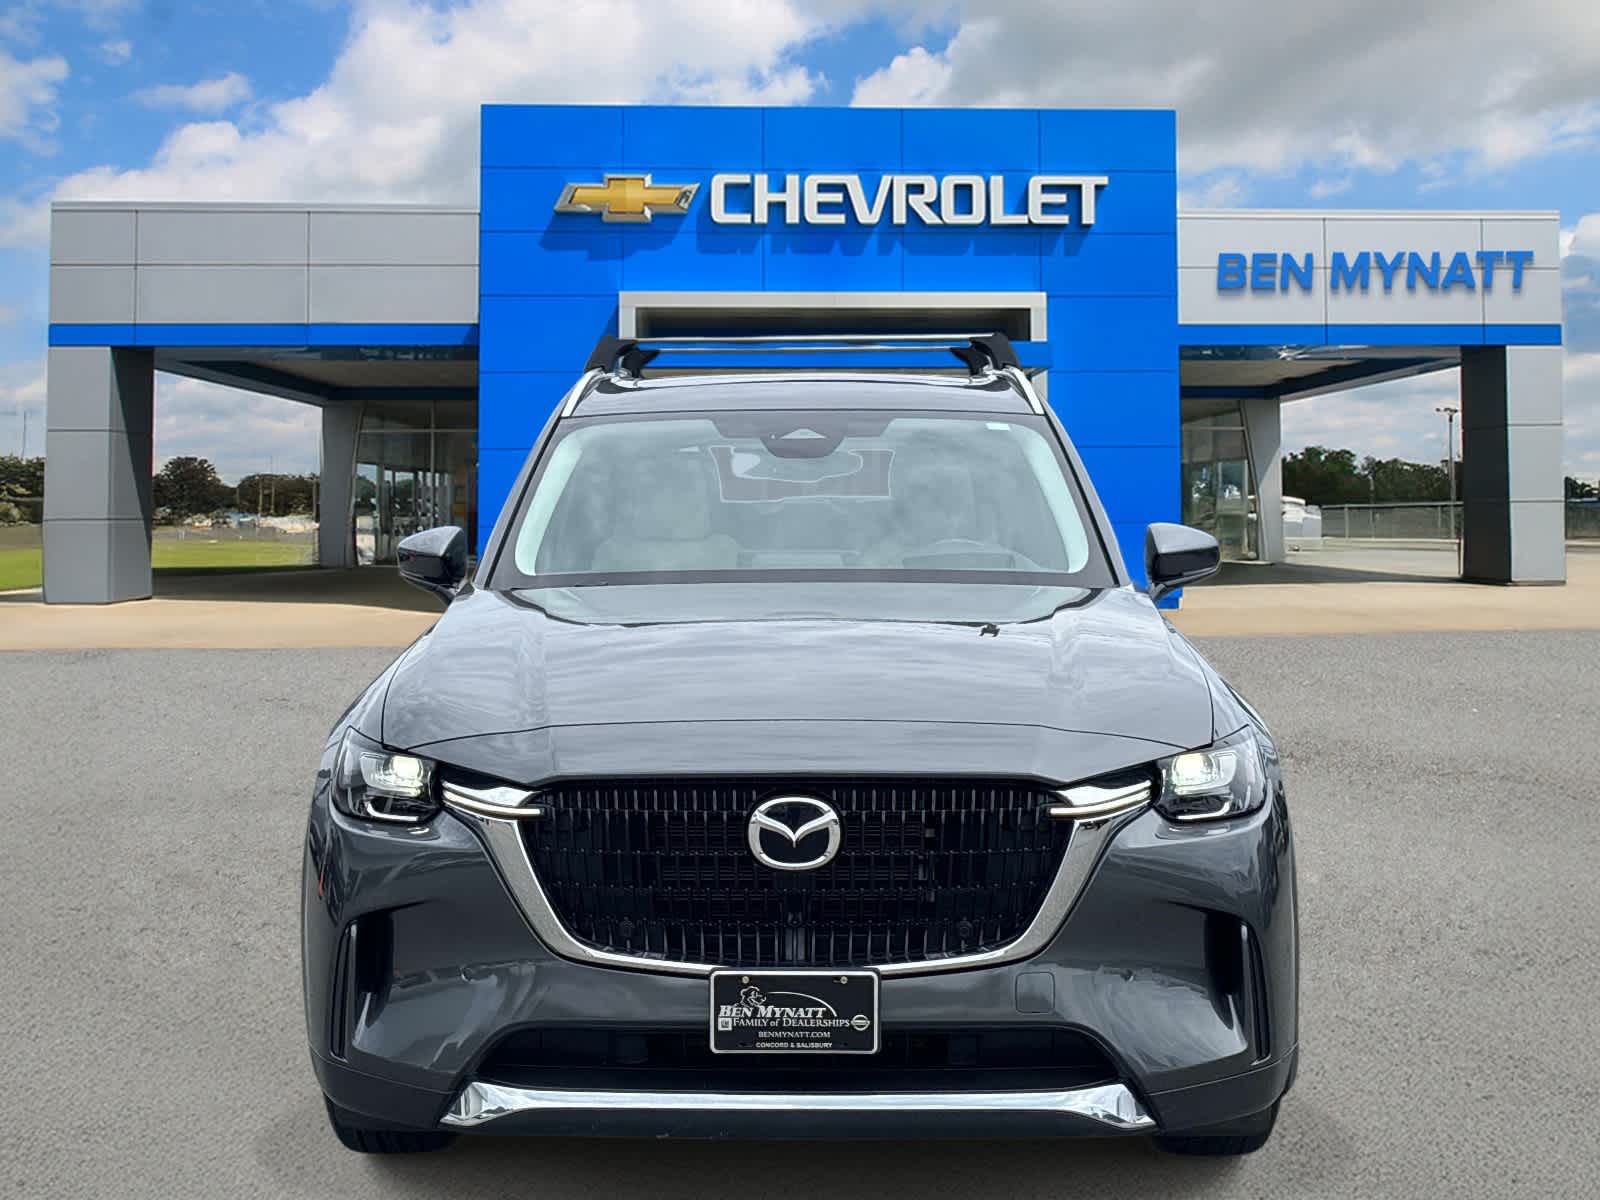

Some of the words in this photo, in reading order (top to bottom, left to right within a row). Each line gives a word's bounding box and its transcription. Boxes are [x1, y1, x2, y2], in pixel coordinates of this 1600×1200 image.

[710, 173, 1109, 226] CHEVROLET
[1217, 252, 1314, 291] BEN
[1330, 250, 1534, 290] MYNATT
[719, 1005, 753, 1018] BEN
[757, 1005, 827, 1018] MYNATT
[733, 1017, 769, 1027] FAMILY
[769, 1018, 780, 1027] of
[782, 1017, 850, 1027] DEALERSHIPS
[758, 1031, 831, 1039] BENMYNATT.COM
